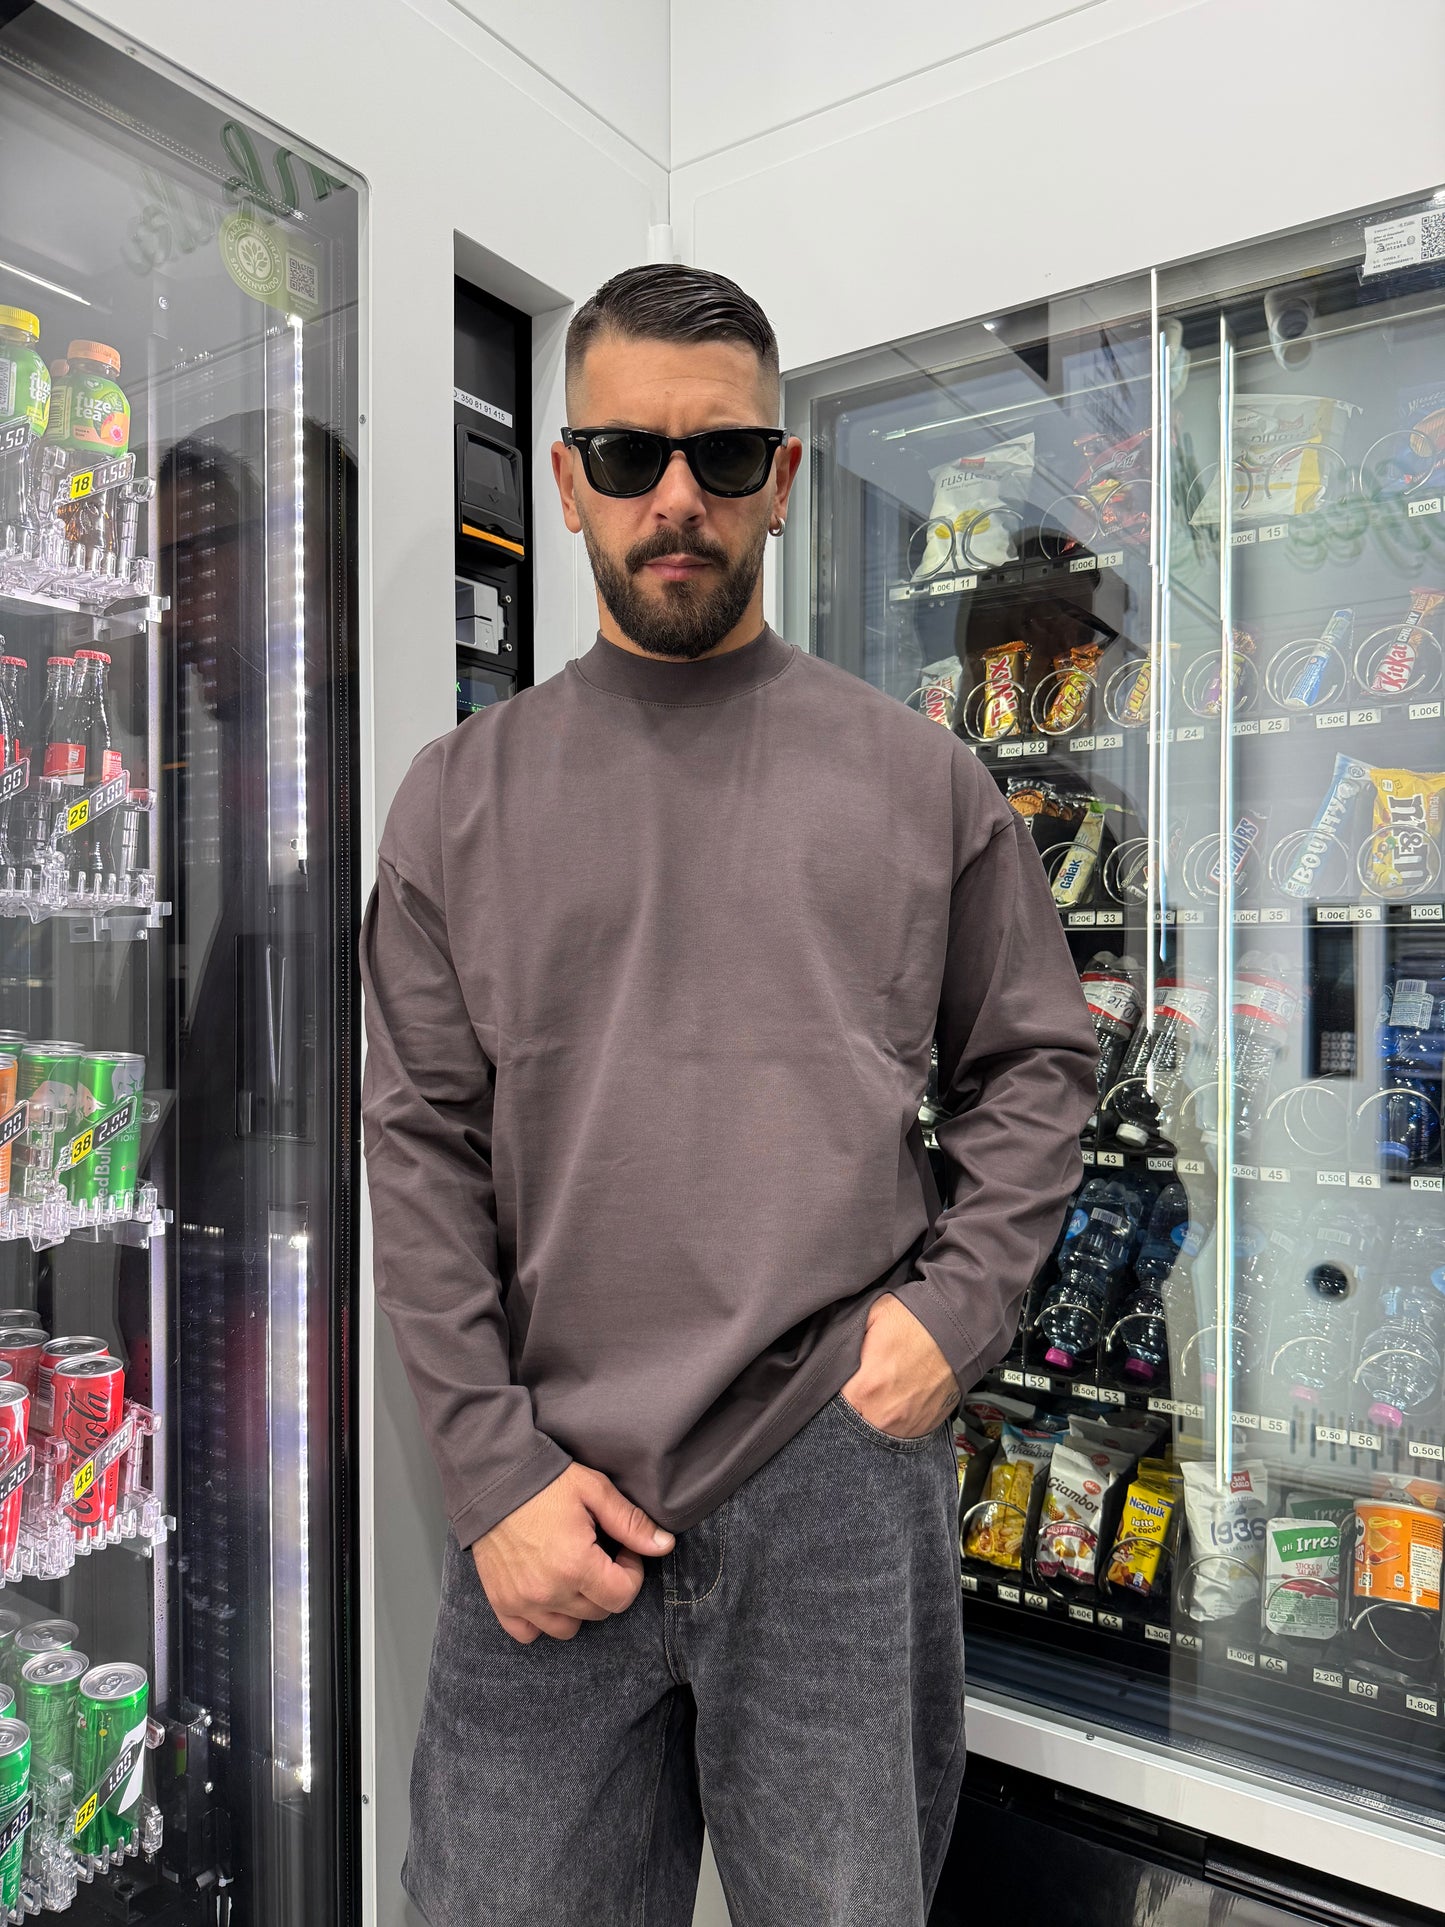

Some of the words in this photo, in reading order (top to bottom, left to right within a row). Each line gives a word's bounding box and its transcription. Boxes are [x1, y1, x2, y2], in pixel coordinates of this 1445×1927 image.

[75, 391, 112, 413] fuze
[460, 392, 474, 405] 350
[474, 399, 483, 410] 81
[483, 404, 492, 415] 91
[492, 408, 506, 421] 415
[75, 407, 102, 422] tea
[0, 427, 25, 450] .50
[102, 461, 127, 484] 1.50
[74, 476, 90, 492] 18
[1409, 503, 1438, 515] 1.00€
[1266, 527, 1281, 539] 15
[1103, 554, 1118, 566] 13
[961, 578, 971, 589] 11
[1381, 643, 1415, 691] KitKat
[1357, 712, 1373, 723] 26
[1410, 705, 1439, 718] 1.00€
[1267, 720, 1282, 731] 25
[1318, 714, 1345, 726] 1.50€
[1184, 728, 1198, 739] 24
[1029, 742, 1045, 753] 22
[1103, 737, 1117, 747] 23
[95, 779, 124, 812] 2.00
[1429, 795, 1440, 821] PEANUT
[70, 804, 87, 826] 28
[1297, 795, 1347, 885] BOUNTY
[1060, 859, 1082, 889] Galak
[1103, 913, 1116, 923] 33
[1184, 911, 1199, 922] 34
[1268, 910, 1283, 921] 35
[1357, 908, 1373, 919] 36
[99, 1109, 129, 1142] 2.00
[73, 1139, 91, 1158] 38
[96, 1146, 112, 1177] Bull
[1103, 1154, 1117, 1164] 43
[1184, 1162, 1199, 1173] 44
[1267, 1170, 1283, 1180] 45
[1356, 1175, 1373, 1186] 46
[1029, 1377, 1046, 1388] 52
[1103, 1391, 1120, 1402] 53
[1184, 1404, 1200, 1416] 54
[1268, 1419, 1283, 1431] 55
[1357, 1435, 1373, 1447] 56
[1412, 1445, 1441, 1457] 0.50€
[75, 1464, 93, 1490] 48
[1231, 1480, 1250, 1488] CARLO
[1129, 1496, 1165, 1519] Nesquik
[1131, 1516, 1155, 1528] latte
[1138, 1525, 1162, 1534] cacao
[1211, 1517, 1267, 1547] 1936
[1281, 1542, 1293, 1552] gli
[1296, 1562, 1316, 1571] STICKS
[1296, 1569, 1321, 1577] SALAME
[1028, 1596, 1044, 1608] 62
[1102, 1615, 1119, 1628] 63
[1181, 1635, 1197, 1647] 64
[1266, 1657, 1283, 1671] 65
[1315, 1671, 1342, 1683] 2.20€
[1355, 1682, 1374, 1696] 66
[76, 1799, 96, 1829] 58
